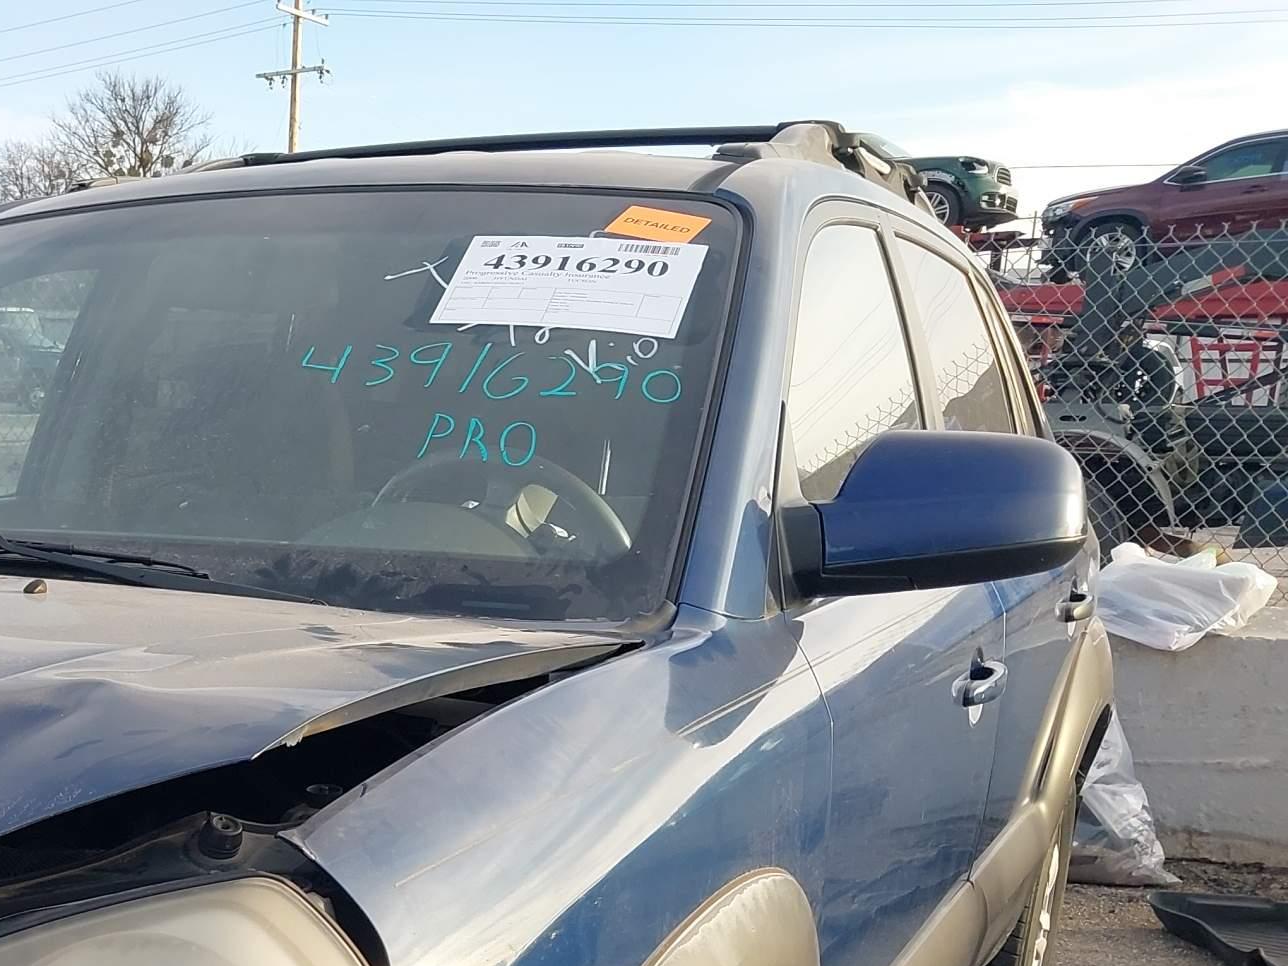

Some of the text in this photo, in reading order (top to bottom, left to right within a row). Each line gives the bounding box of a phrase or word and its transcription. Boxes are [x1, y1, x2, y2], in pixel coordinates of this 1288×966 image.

[624, 217, 691, 234] DETAILED
[483, 254, 670, 278] 43916290
[302, 342, 682, 403] 43916290
[417, 413, 537, 466] PRO
